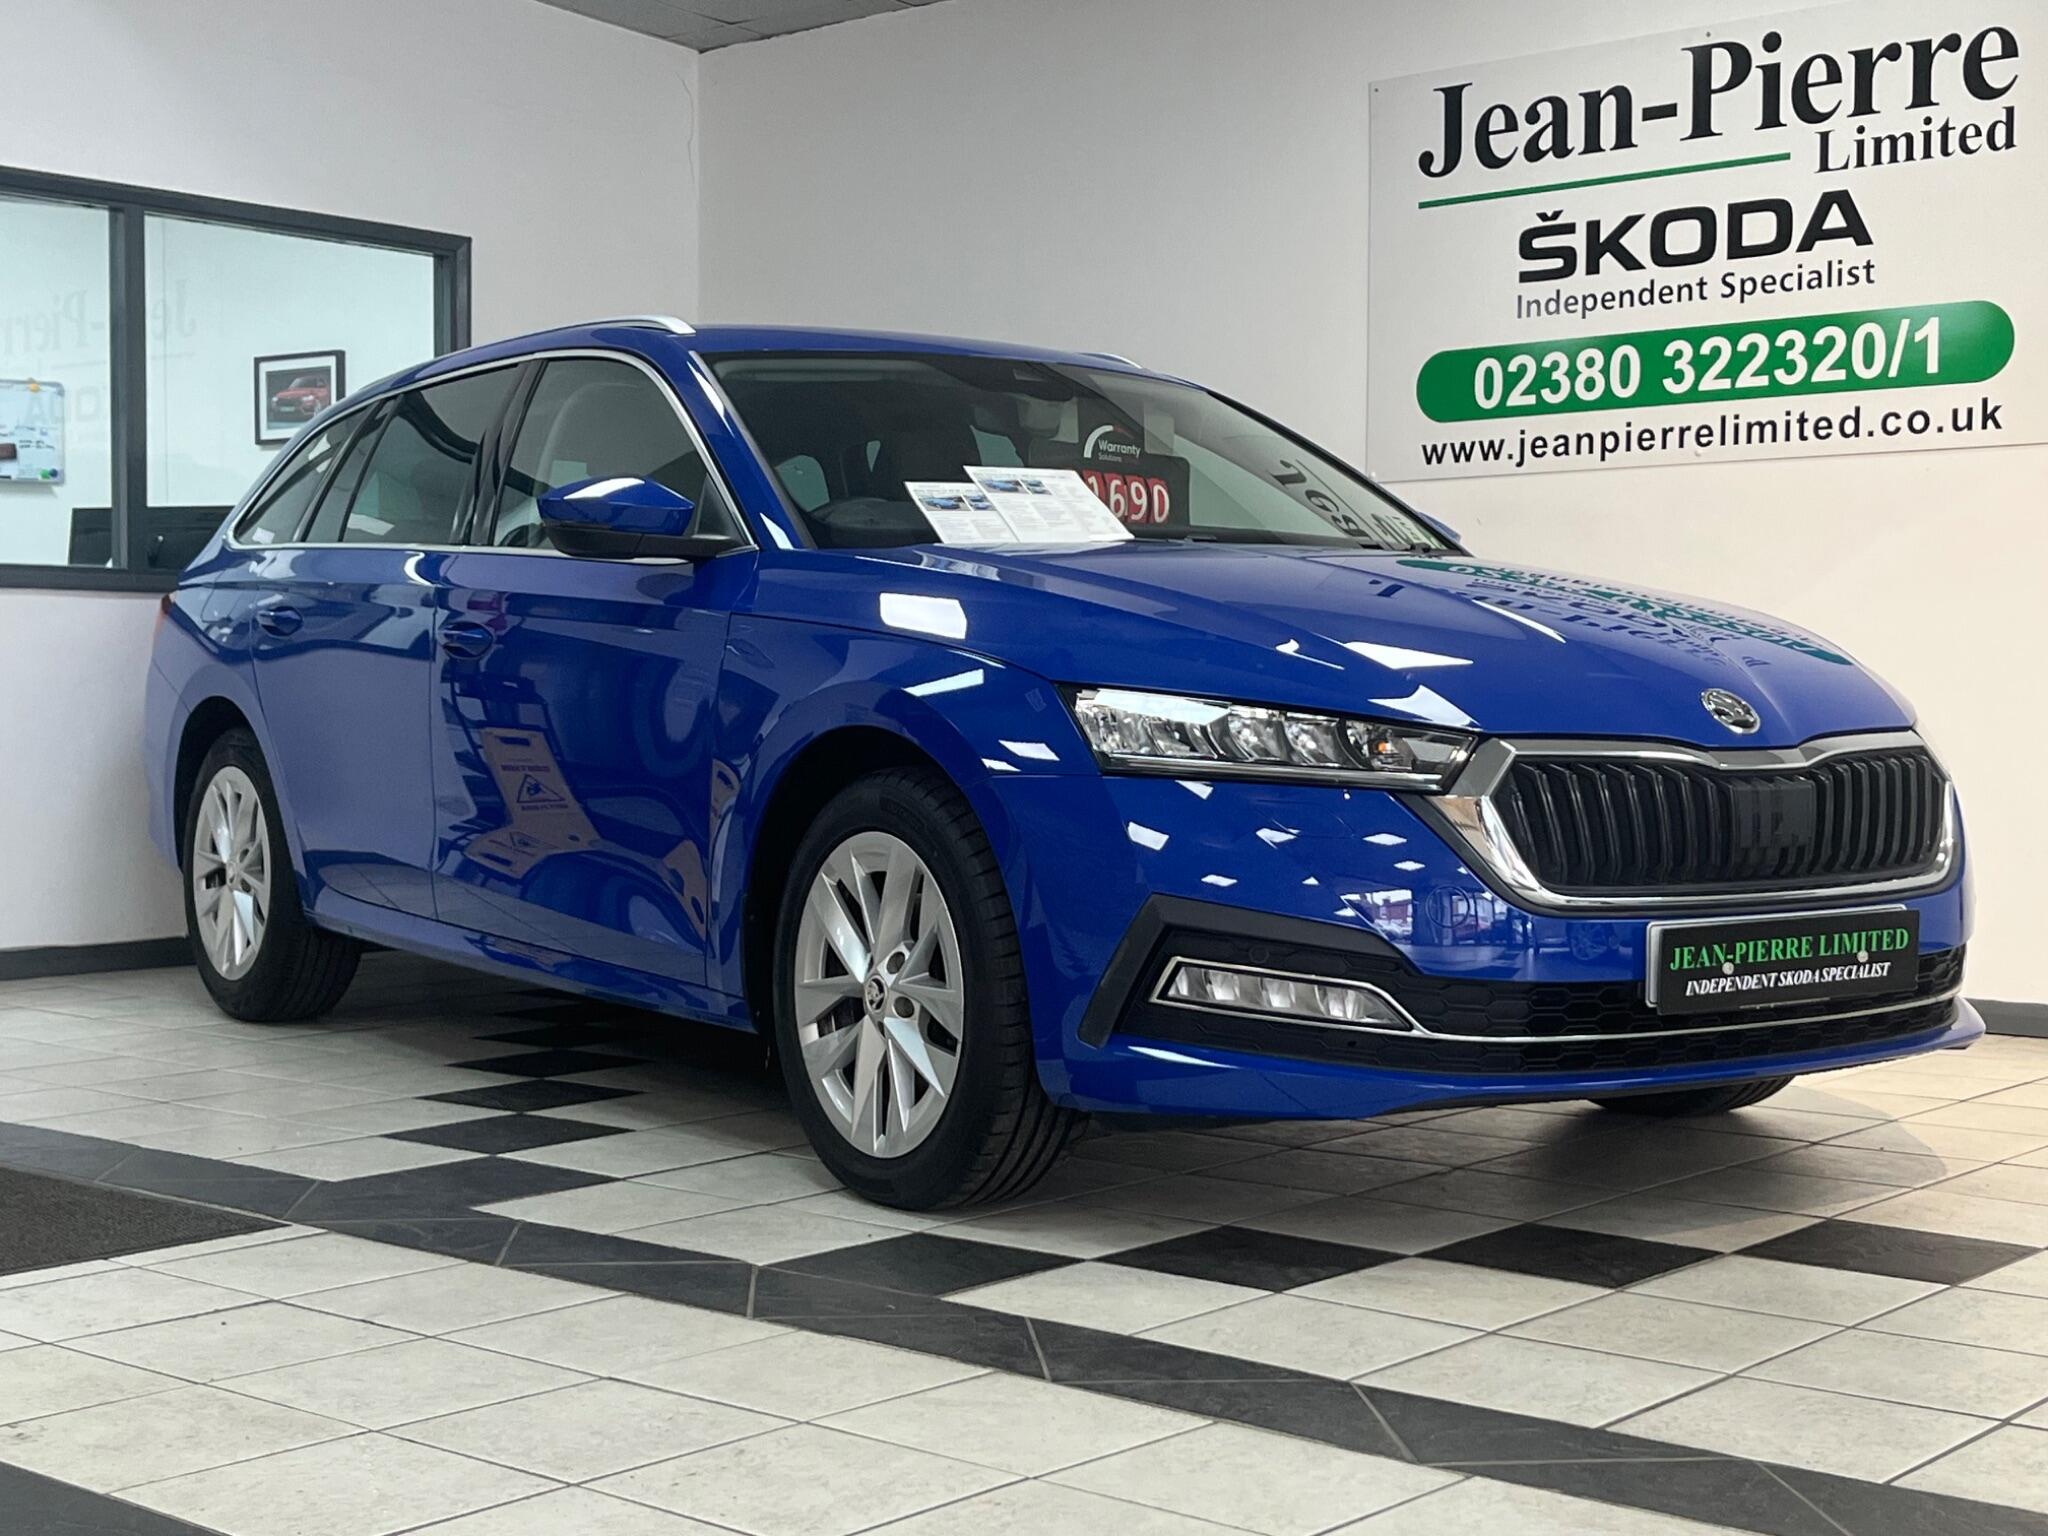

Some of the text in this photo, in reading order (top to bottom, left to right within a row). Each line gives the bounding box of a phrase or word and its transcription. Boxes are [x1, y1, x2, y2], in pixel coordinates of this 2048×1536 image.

[1418, 26, 2019, 178] Jean-Pierre
[1815, 106, 2018, 174] Limited
[1517, 188, 1874, 284] ŠKODA
[1516, 258, 1876, 319] Independent Specialist
[1474, 317, 1941, 411] 02380 322320/1
[1098, 440, 1141, 458] Warranty
[1421, 397, 2003, 466] www.jeanpierrelimited.co.uk
[1670, 928, 1910, 971] JEAN-PIERRE LIMITED
[1685, 962, 1892, 997] INDEPENDENT SKODA SPECIALIST
